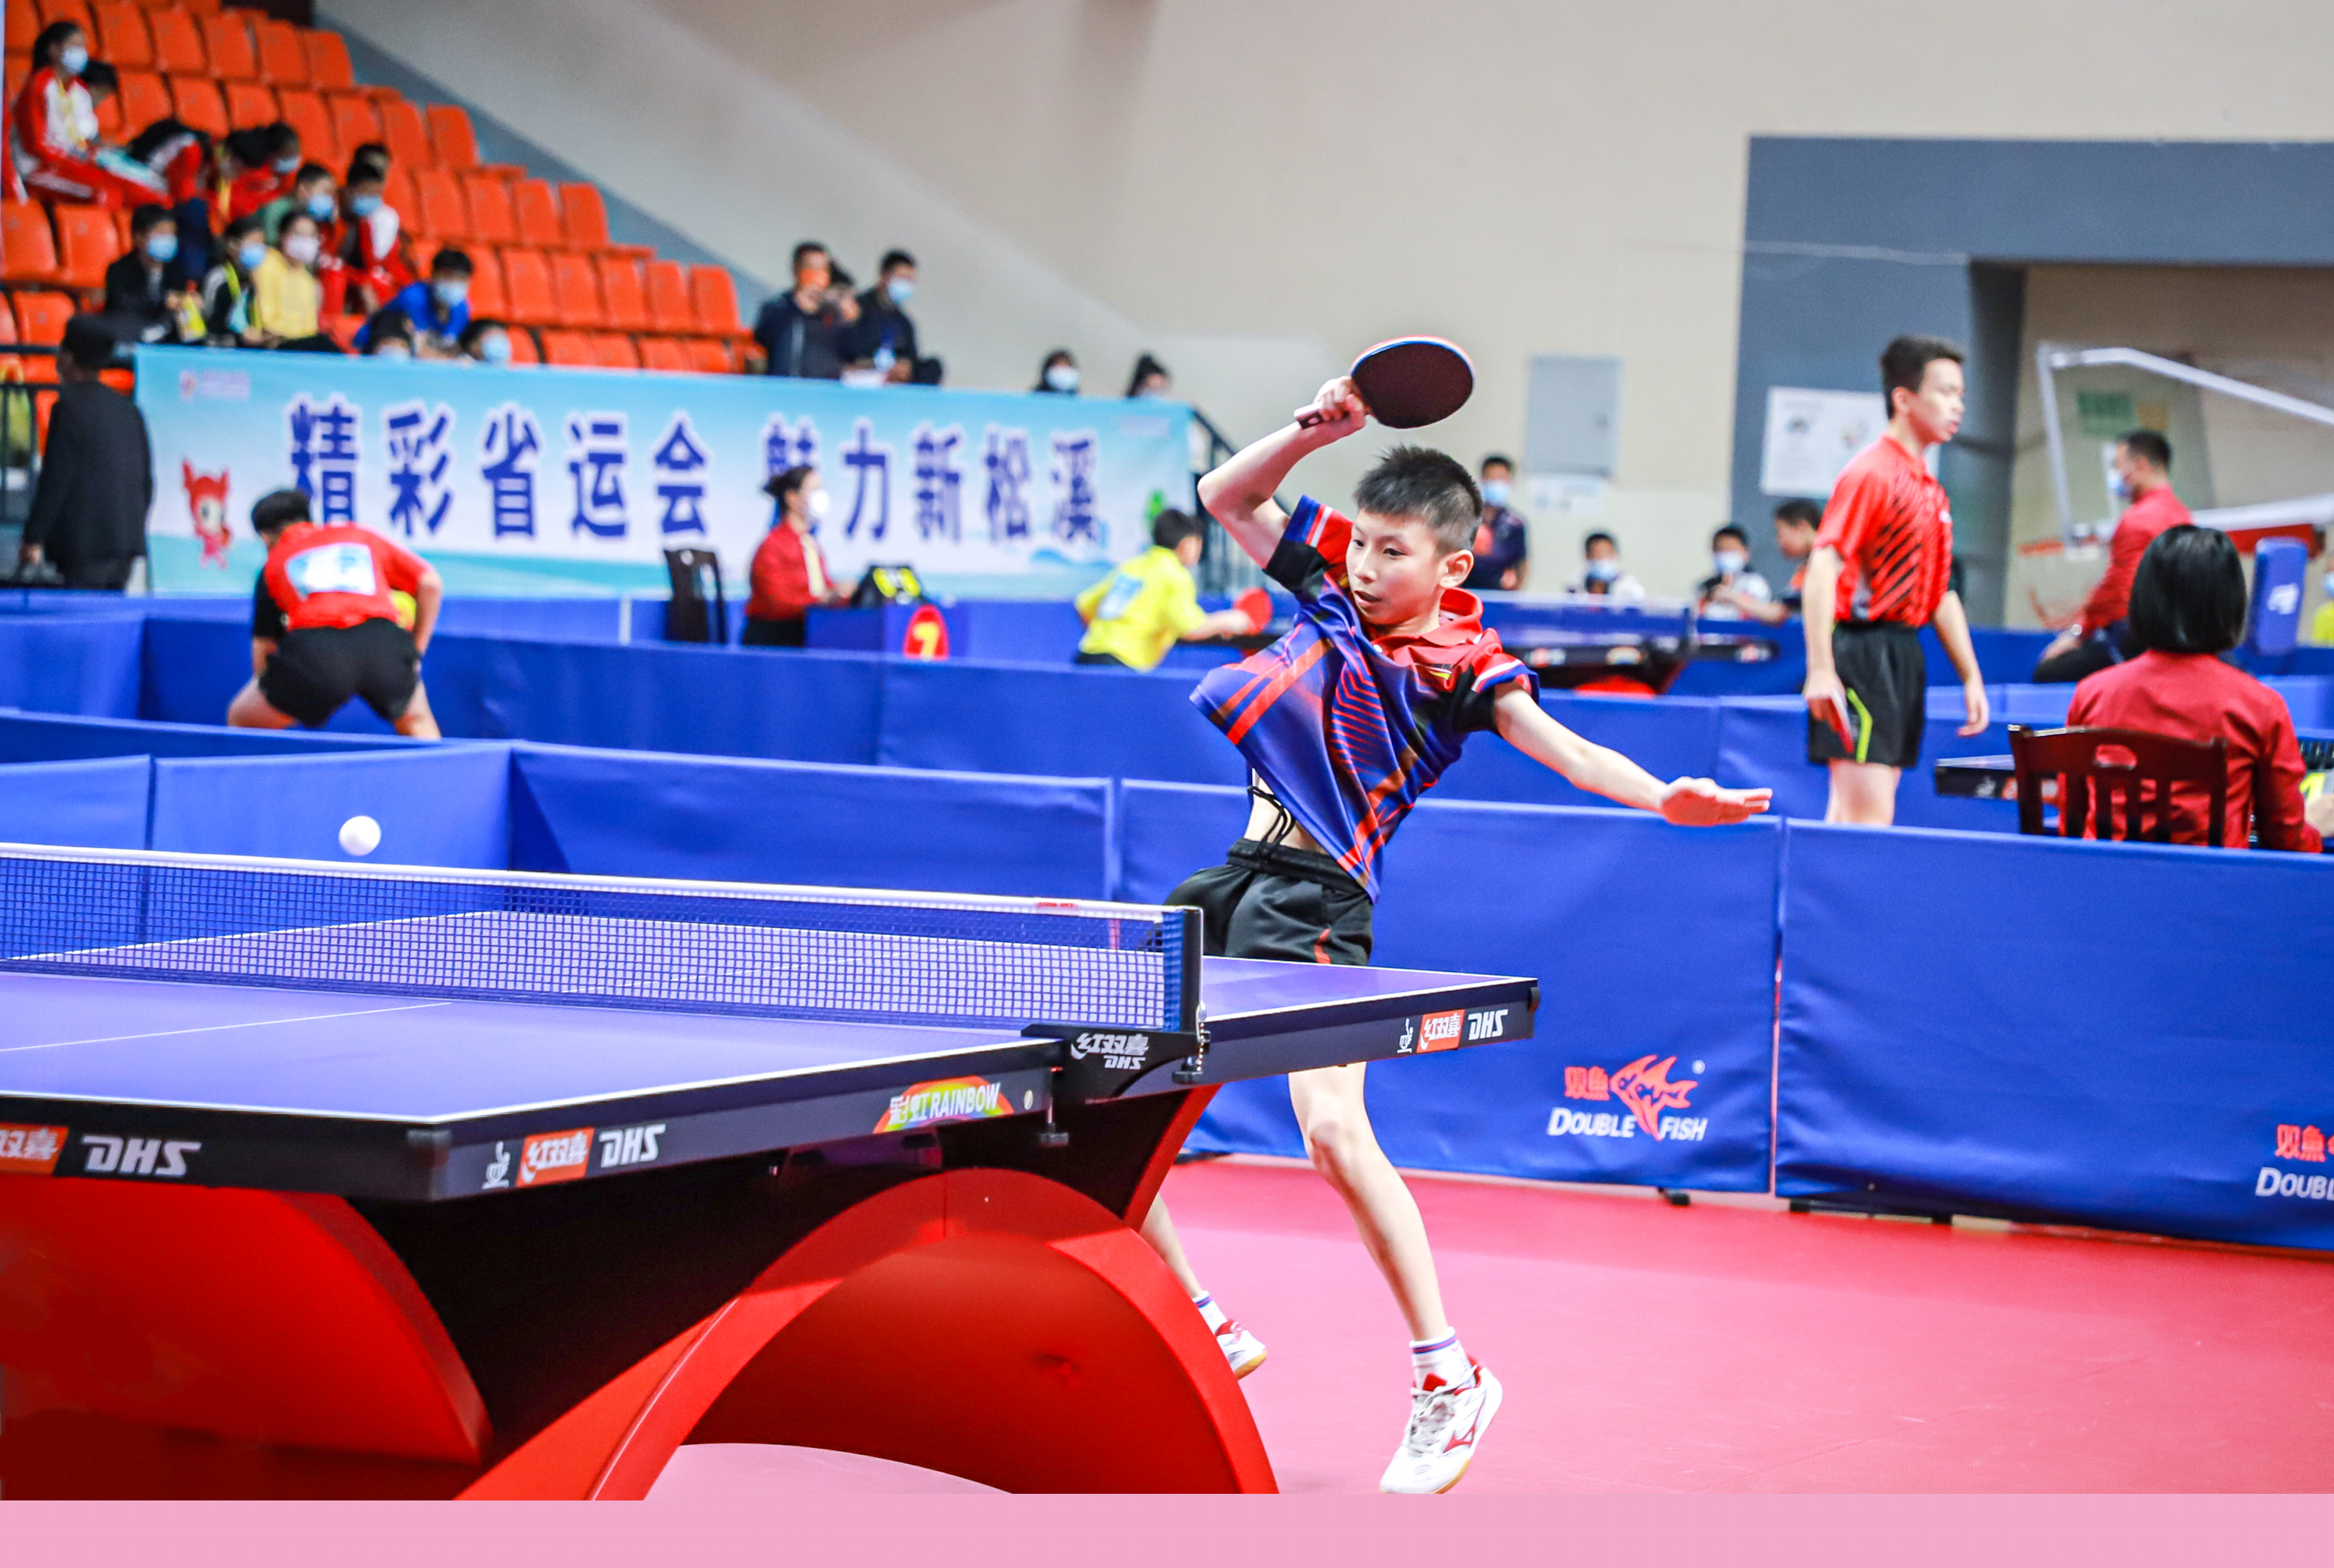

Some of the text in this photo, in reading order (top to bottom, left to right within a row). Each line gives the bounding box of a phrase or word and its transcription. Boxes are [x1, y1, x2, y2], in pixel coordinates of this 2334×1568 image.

[290, 403, 706, 537] 精彩省运会
[1070, 1032, 1149, 1060] 红双喜
[1420, 1009, 1509, 1050] 红双喜 DHS
[1103, 1055, 1146, 1070] DHS
[889, 1082, 1001, 1125] 彩虹 RAINBOW
[1659, 1115, 1708, 1142] FISH
[82, 1134, 202, 1177] DHS
[520, 1124, 666, 1184] 红双喜 DHS
